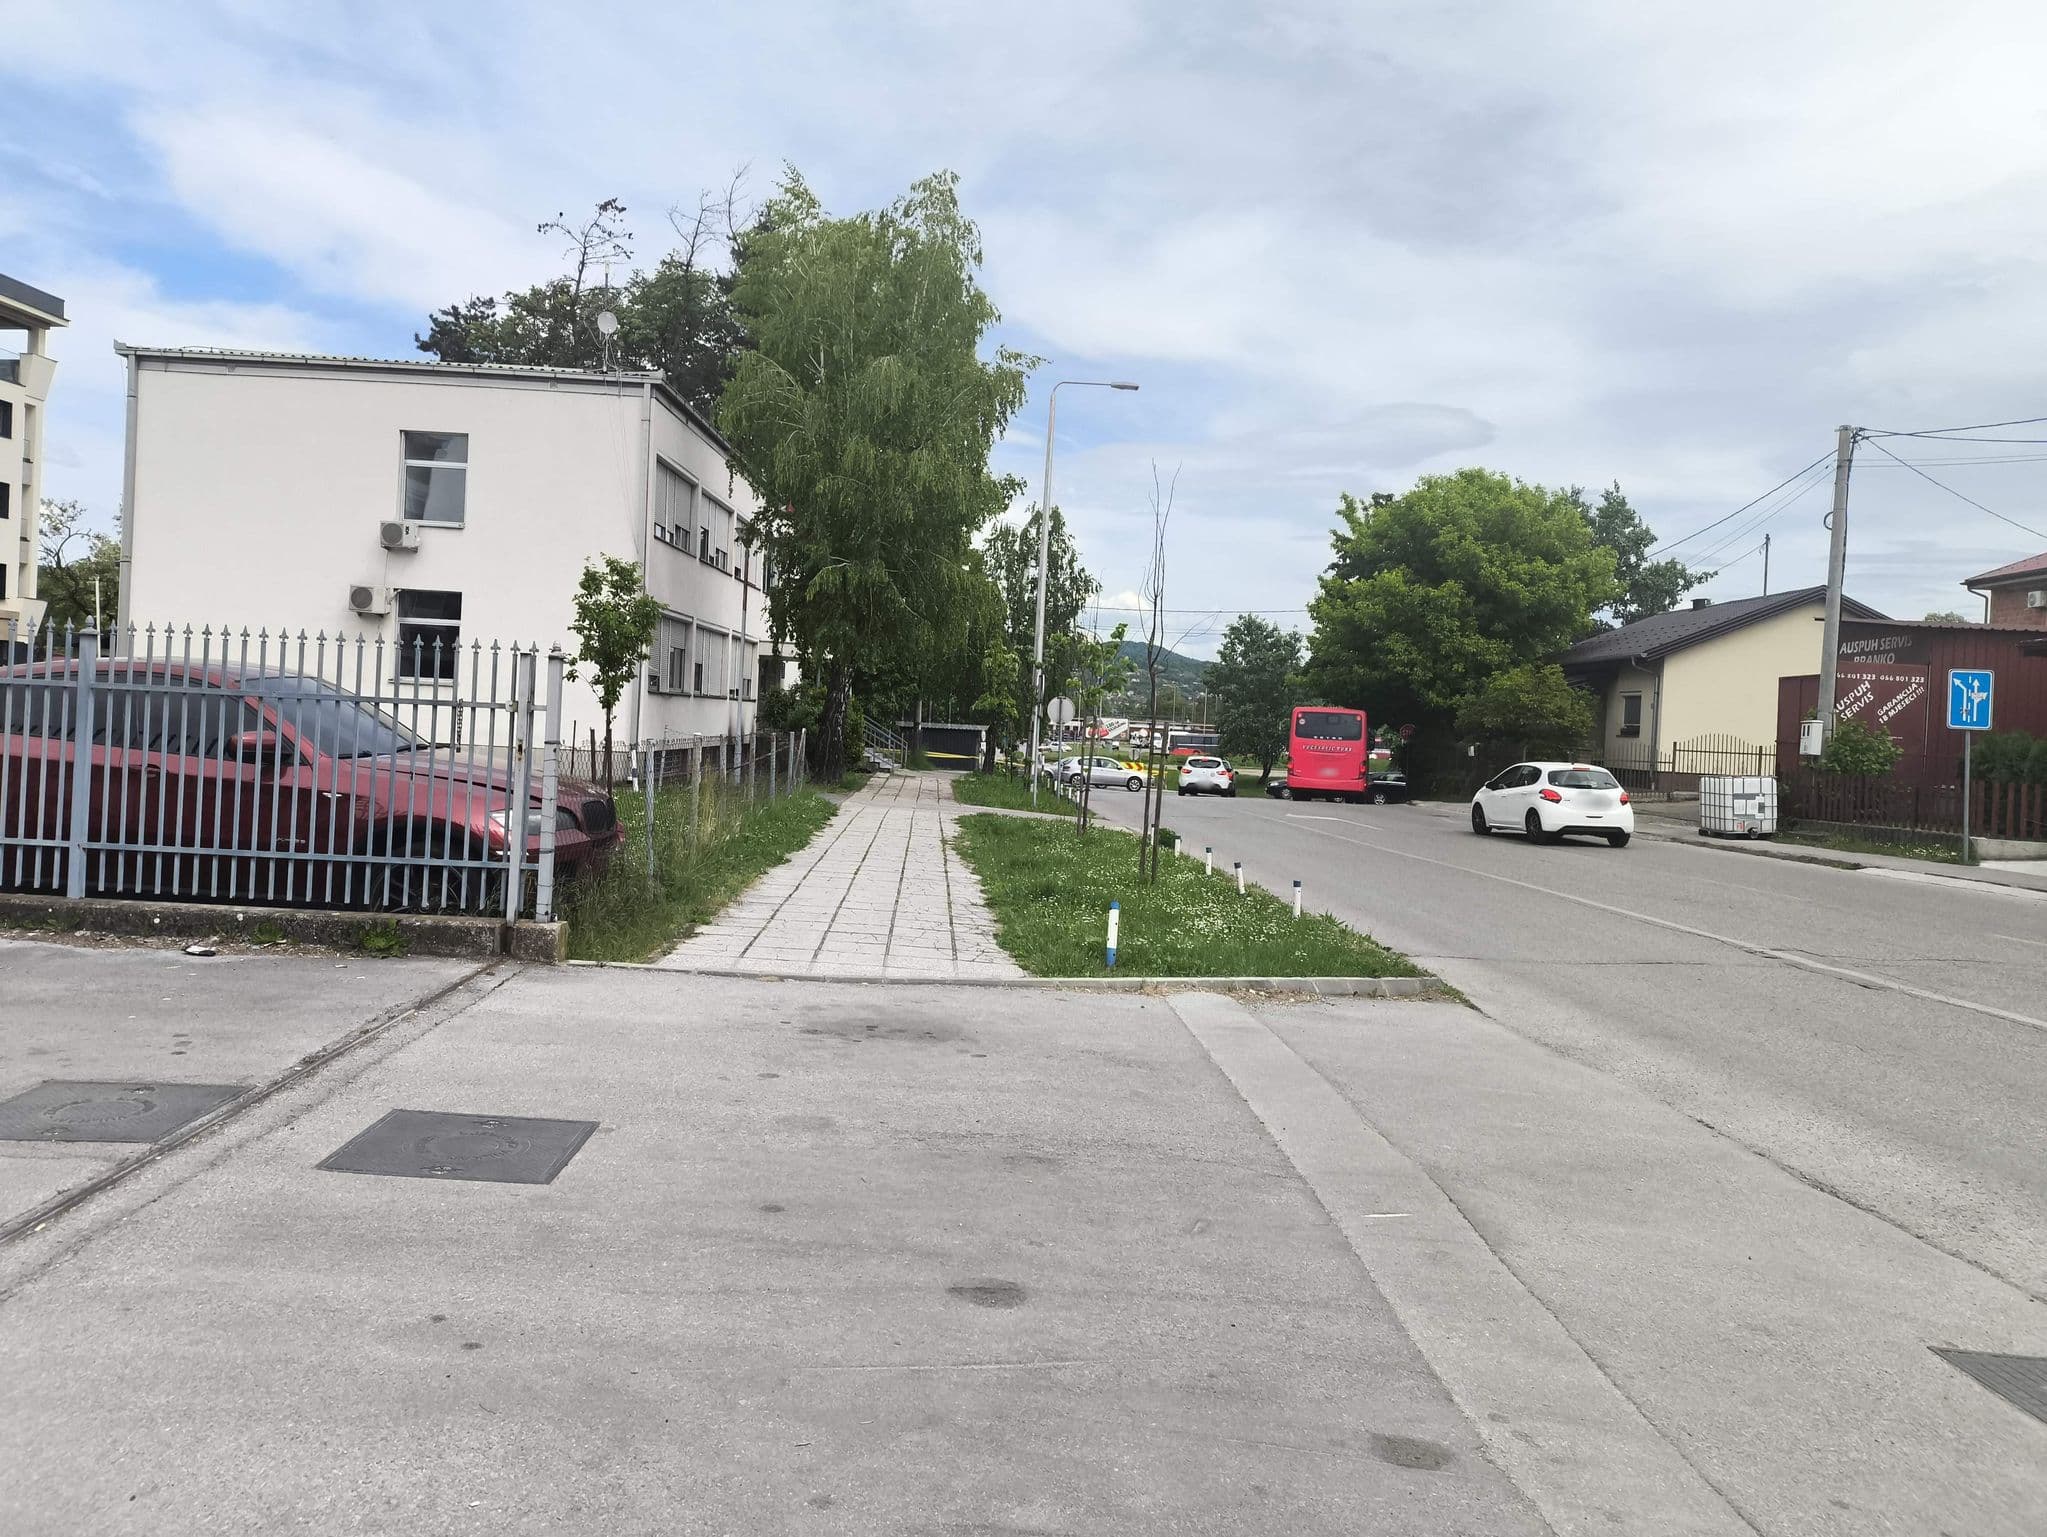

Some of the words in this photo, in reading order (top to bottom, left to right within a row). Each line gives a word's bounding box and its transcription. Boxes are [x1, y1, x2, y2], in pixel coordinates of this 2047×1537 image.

[1839, 639, 1878, 654] AUSPUH
[1880, 636, 1912, 650] SERVIS
[1840, 691, 1874, 722] SERVIS
[1877, 683, 1918, 716] GARANCIJA
[1888, 692, 1917, 718] MJESECI
